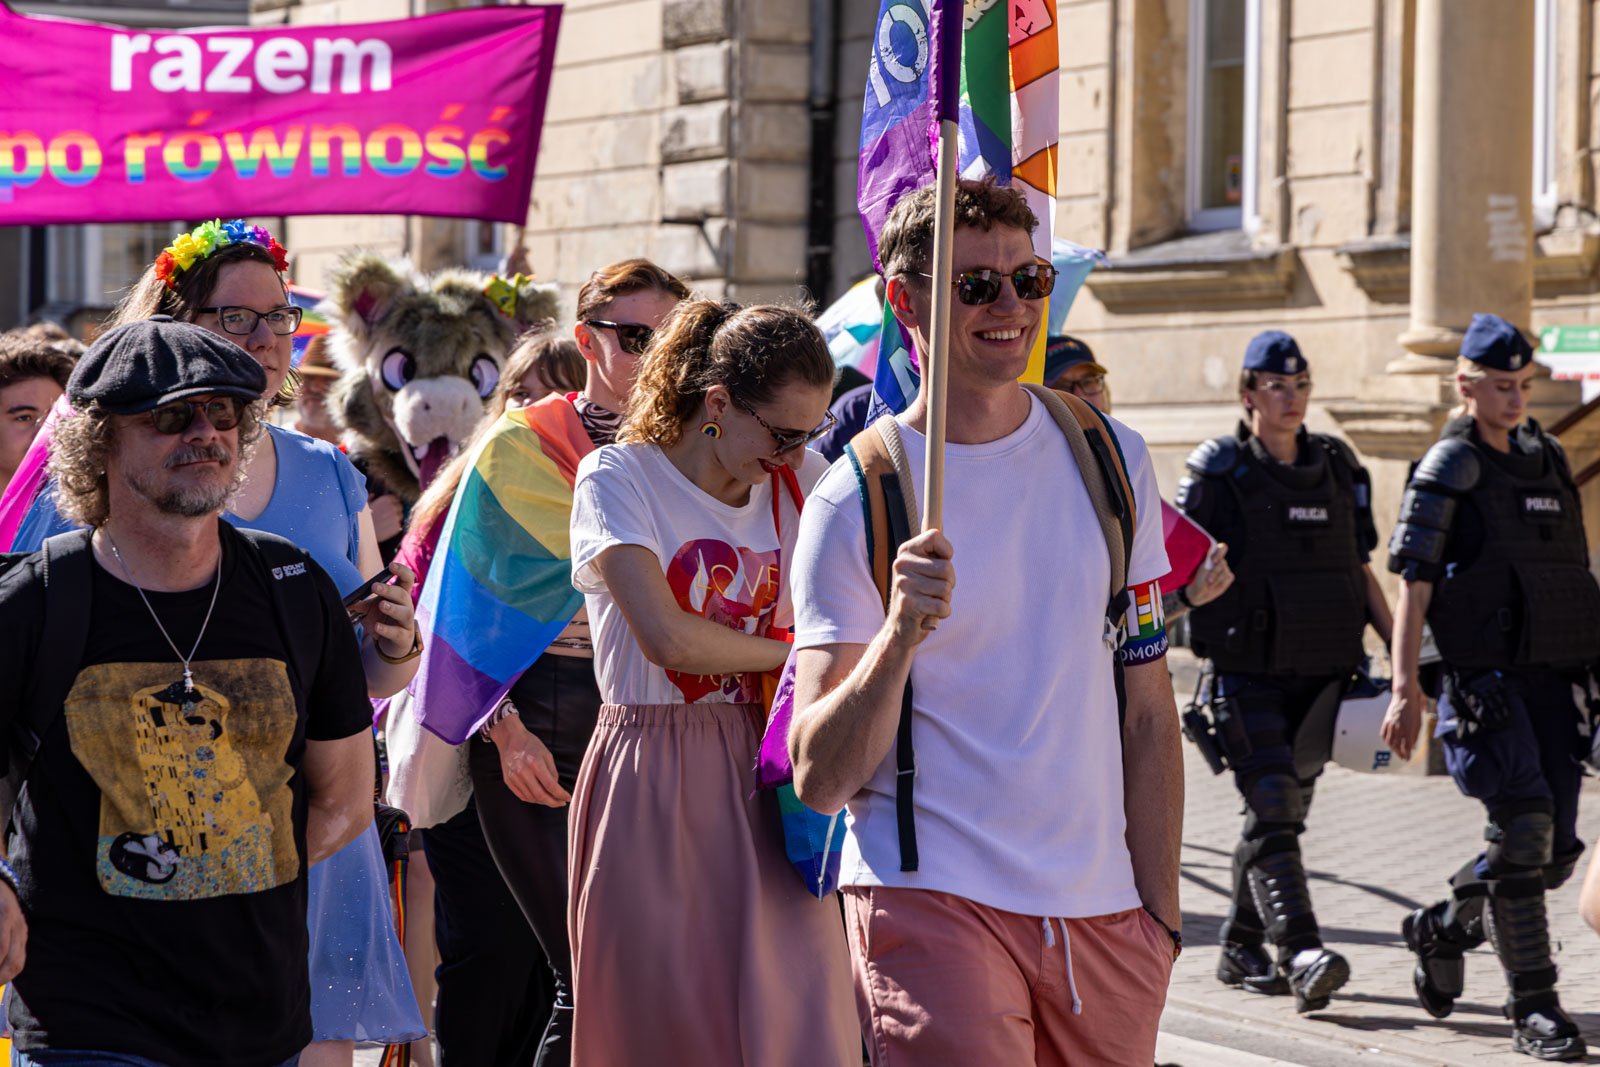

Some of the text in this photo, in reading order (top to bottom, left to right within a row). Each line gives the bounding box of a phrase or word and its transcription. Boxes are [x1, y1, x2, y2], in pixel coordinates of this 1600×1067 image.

[110, 34, 392, 93] razem
[0, 104, 511, 203] po równość
[695, 556, 779, 600] LOVE
